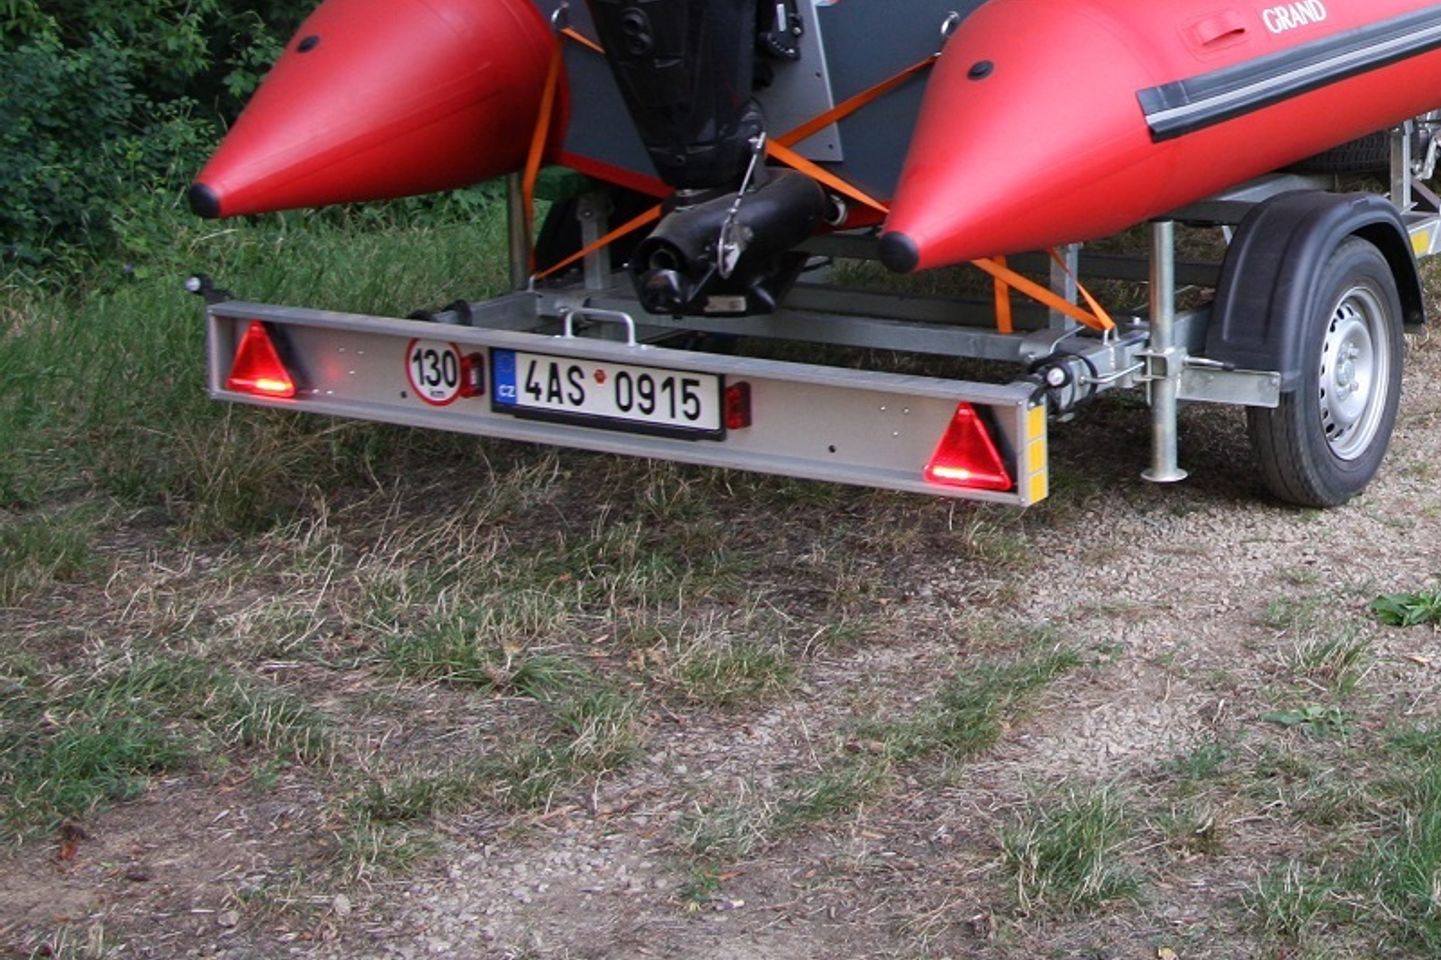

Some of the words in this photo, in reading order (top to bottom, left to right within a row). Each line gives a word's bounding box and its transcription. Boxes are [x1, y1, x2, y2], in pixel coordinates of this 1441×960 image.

[412, 348, 457, 388] 130
[500, 384, 516, 398] CZ
[525, 359, 585, 407] 4AS
[614, 370, 701, 422] 0915
